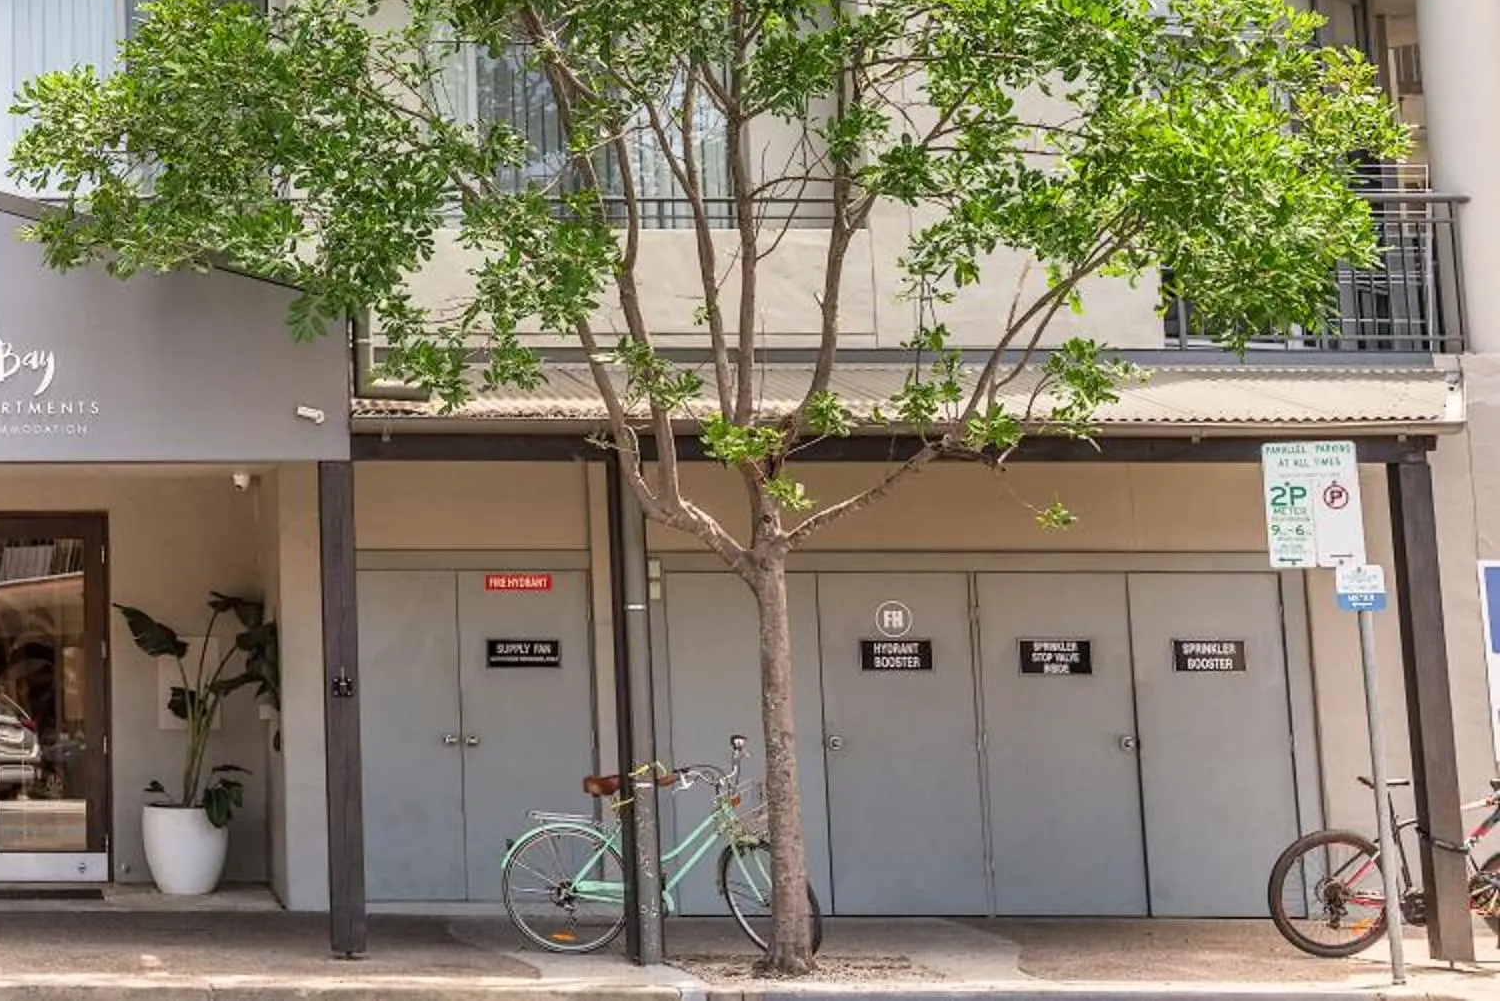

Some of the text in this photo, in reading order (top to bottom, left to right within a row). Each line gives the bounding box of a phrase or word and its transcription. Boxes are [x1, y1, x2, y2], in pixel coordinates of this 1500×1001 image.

[1266, 444, 1352, 455] PARALLEL PARKING
[1277, 458, 1290, 468] AT
[1270, 486, 1308, 507] 2P
[489, 577, 549, 588] FIRE HYDRANT
[883, 610, 903, 628] FH
[496, 643, 552, 654] SUPPLY FAN
[873, 642, 921, 655] HYDRANT
[1033, 642, 1078, 652] SPRINKLER
[1181, 642, 1237, 656] SPRINKLER
[874, 656, 922, 668] BOOSTER
[1032, 652, 1080, 663] STOP VALVE
[1043, 664, 1070, 675] INSIDE
[1187, 658, 1233, 670] BOOSTER
